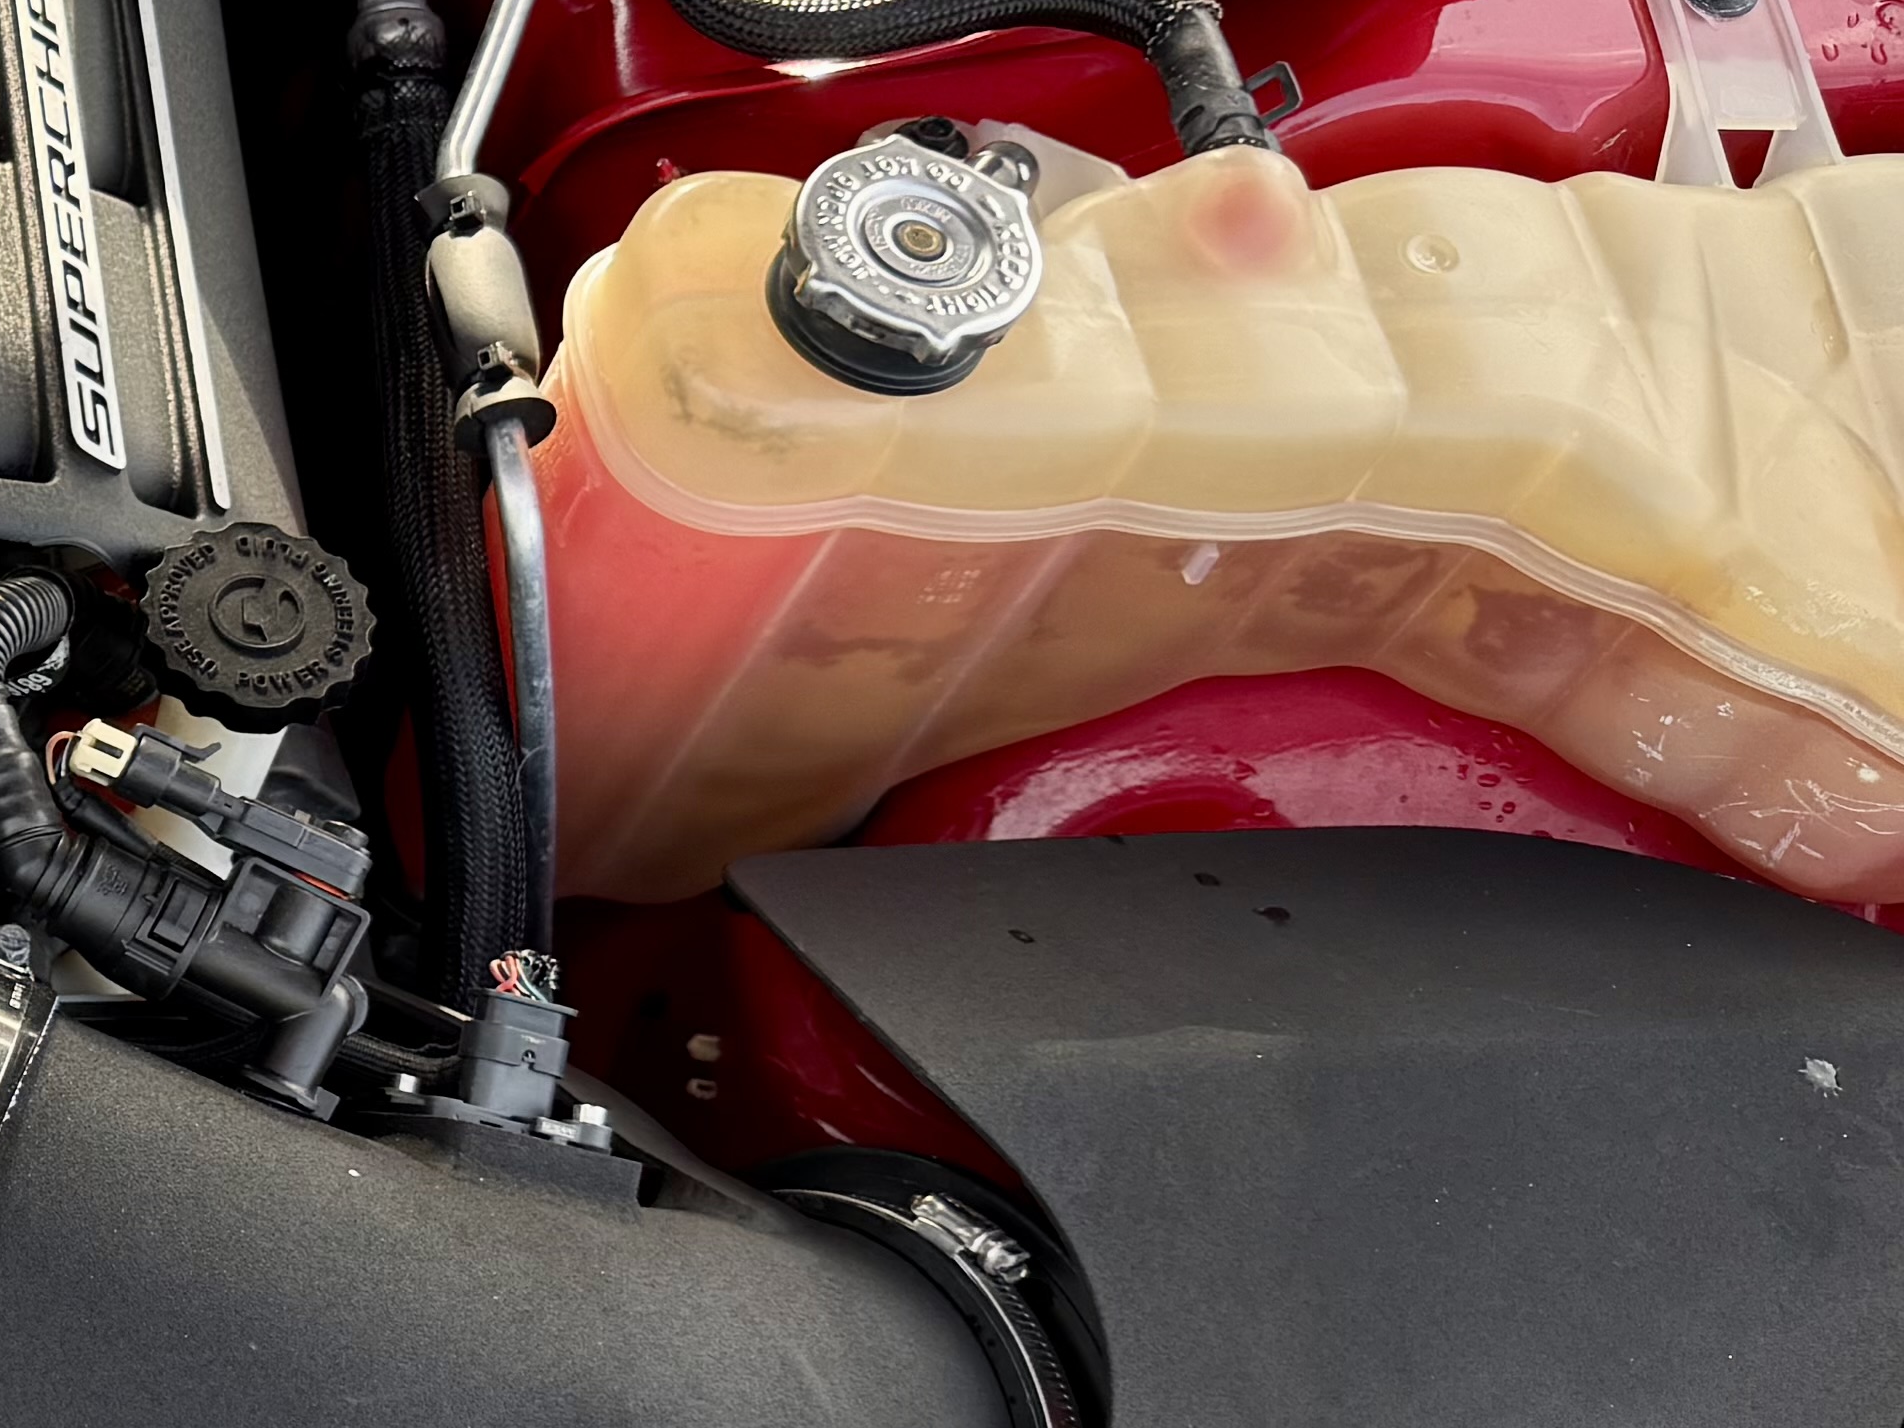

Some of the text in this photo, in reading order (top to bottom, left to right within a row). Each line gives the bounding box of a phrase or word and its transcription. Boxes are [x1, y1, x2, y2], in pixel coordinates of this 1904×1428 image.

[159, 543, 220, 682] USE APPROVED
[235, 536, 355, 695] POWER STEERING FLUID
